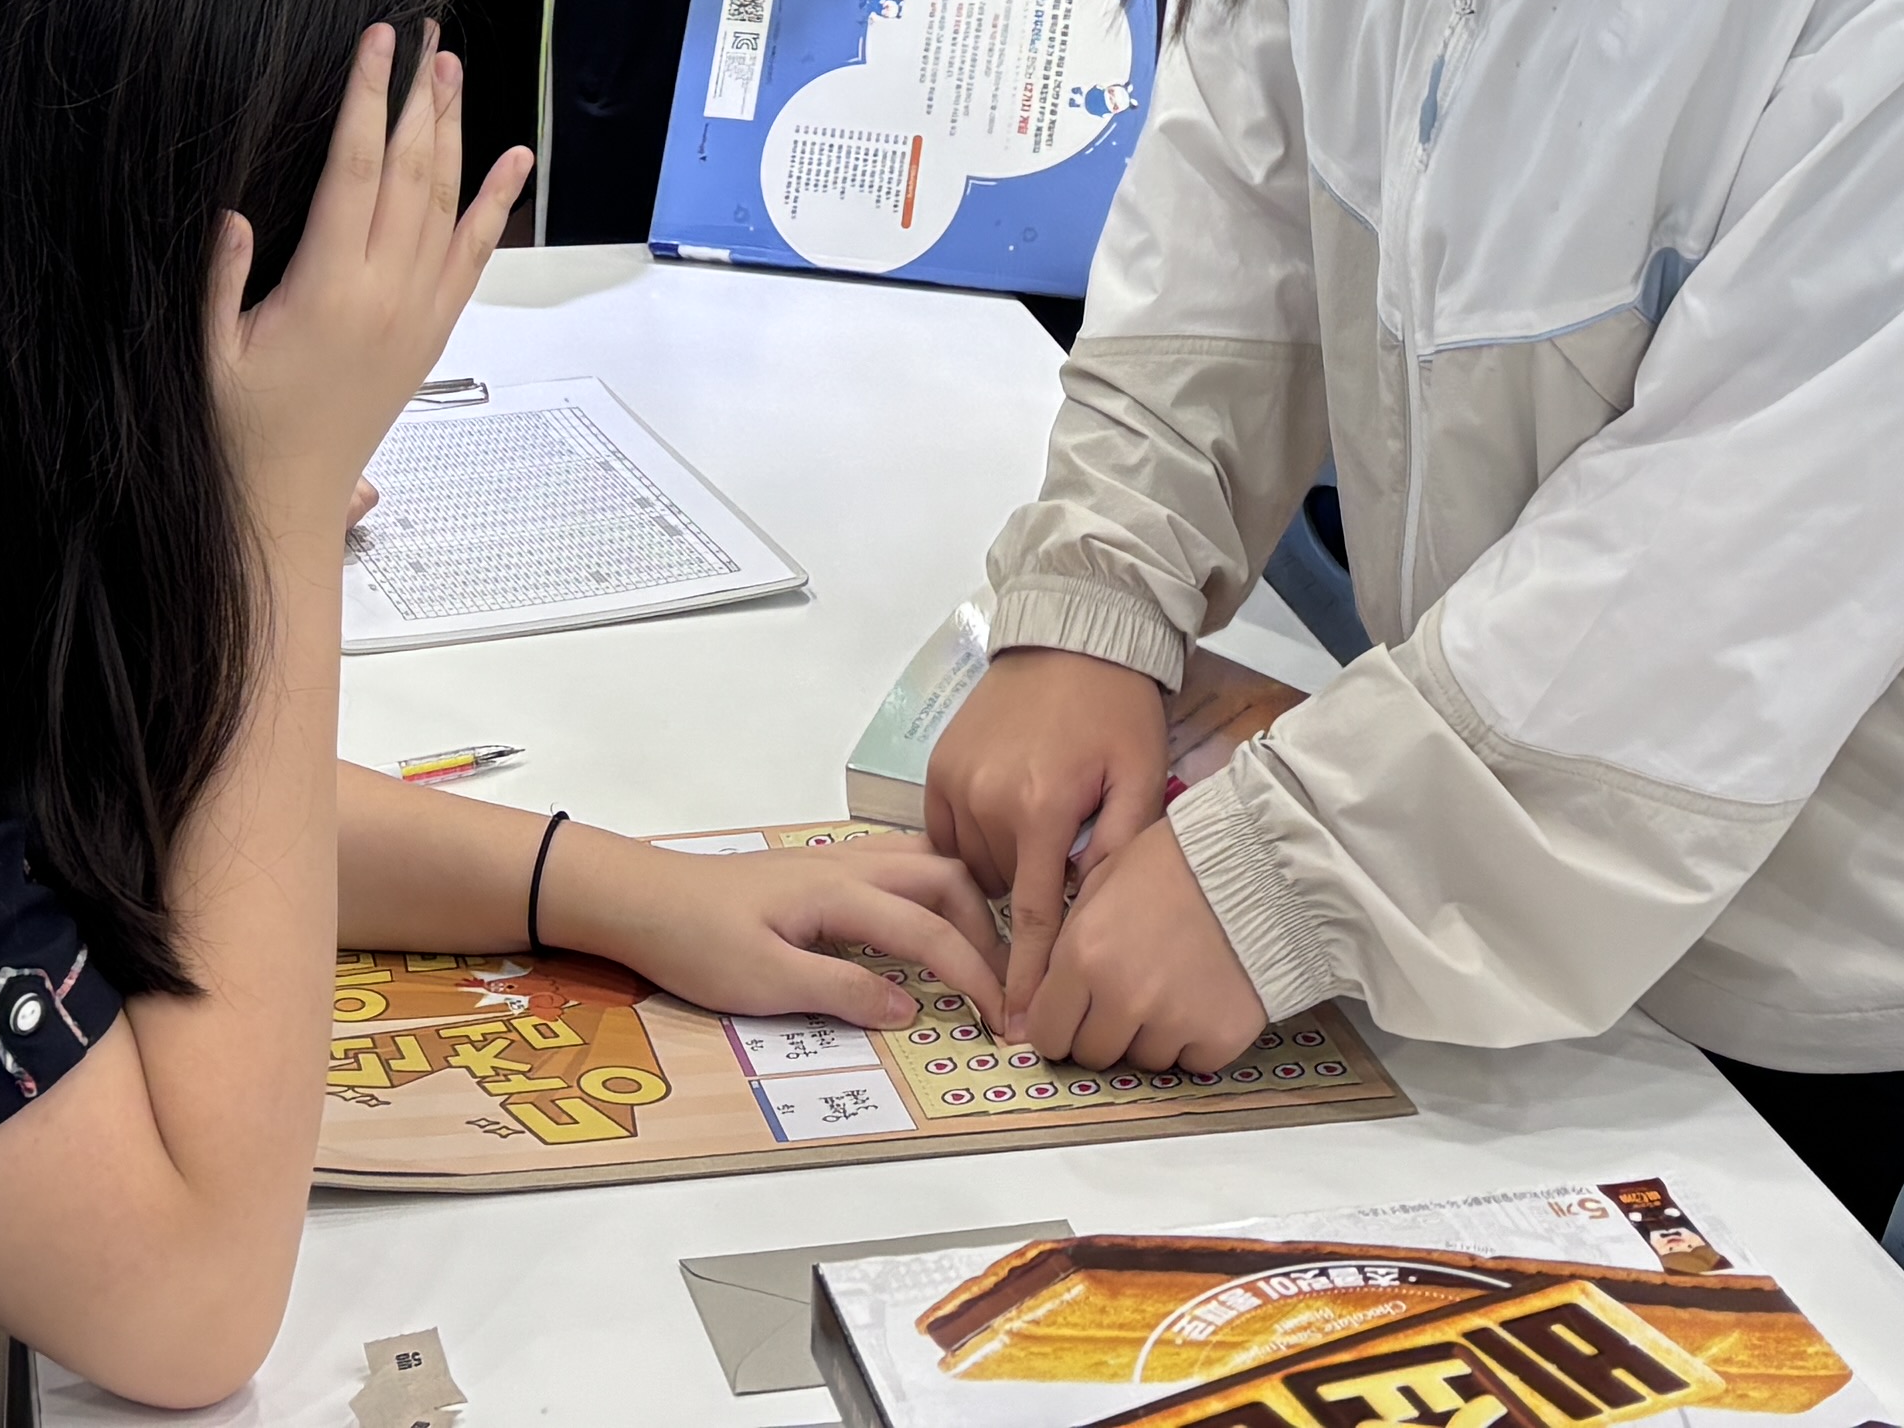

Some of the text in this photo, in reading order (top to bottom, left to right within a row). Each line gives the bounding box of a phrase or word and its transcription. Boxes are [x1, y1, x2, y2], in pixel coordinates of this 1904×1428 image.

[436, 1016, 671, 1144] 당첨
[1547, 1198, 1609, 1221] 5개
[1170, 1266, 1400, 1341] 초콜릿이 통째로
[1322, 1300, 1407, 1334] Chocolate
